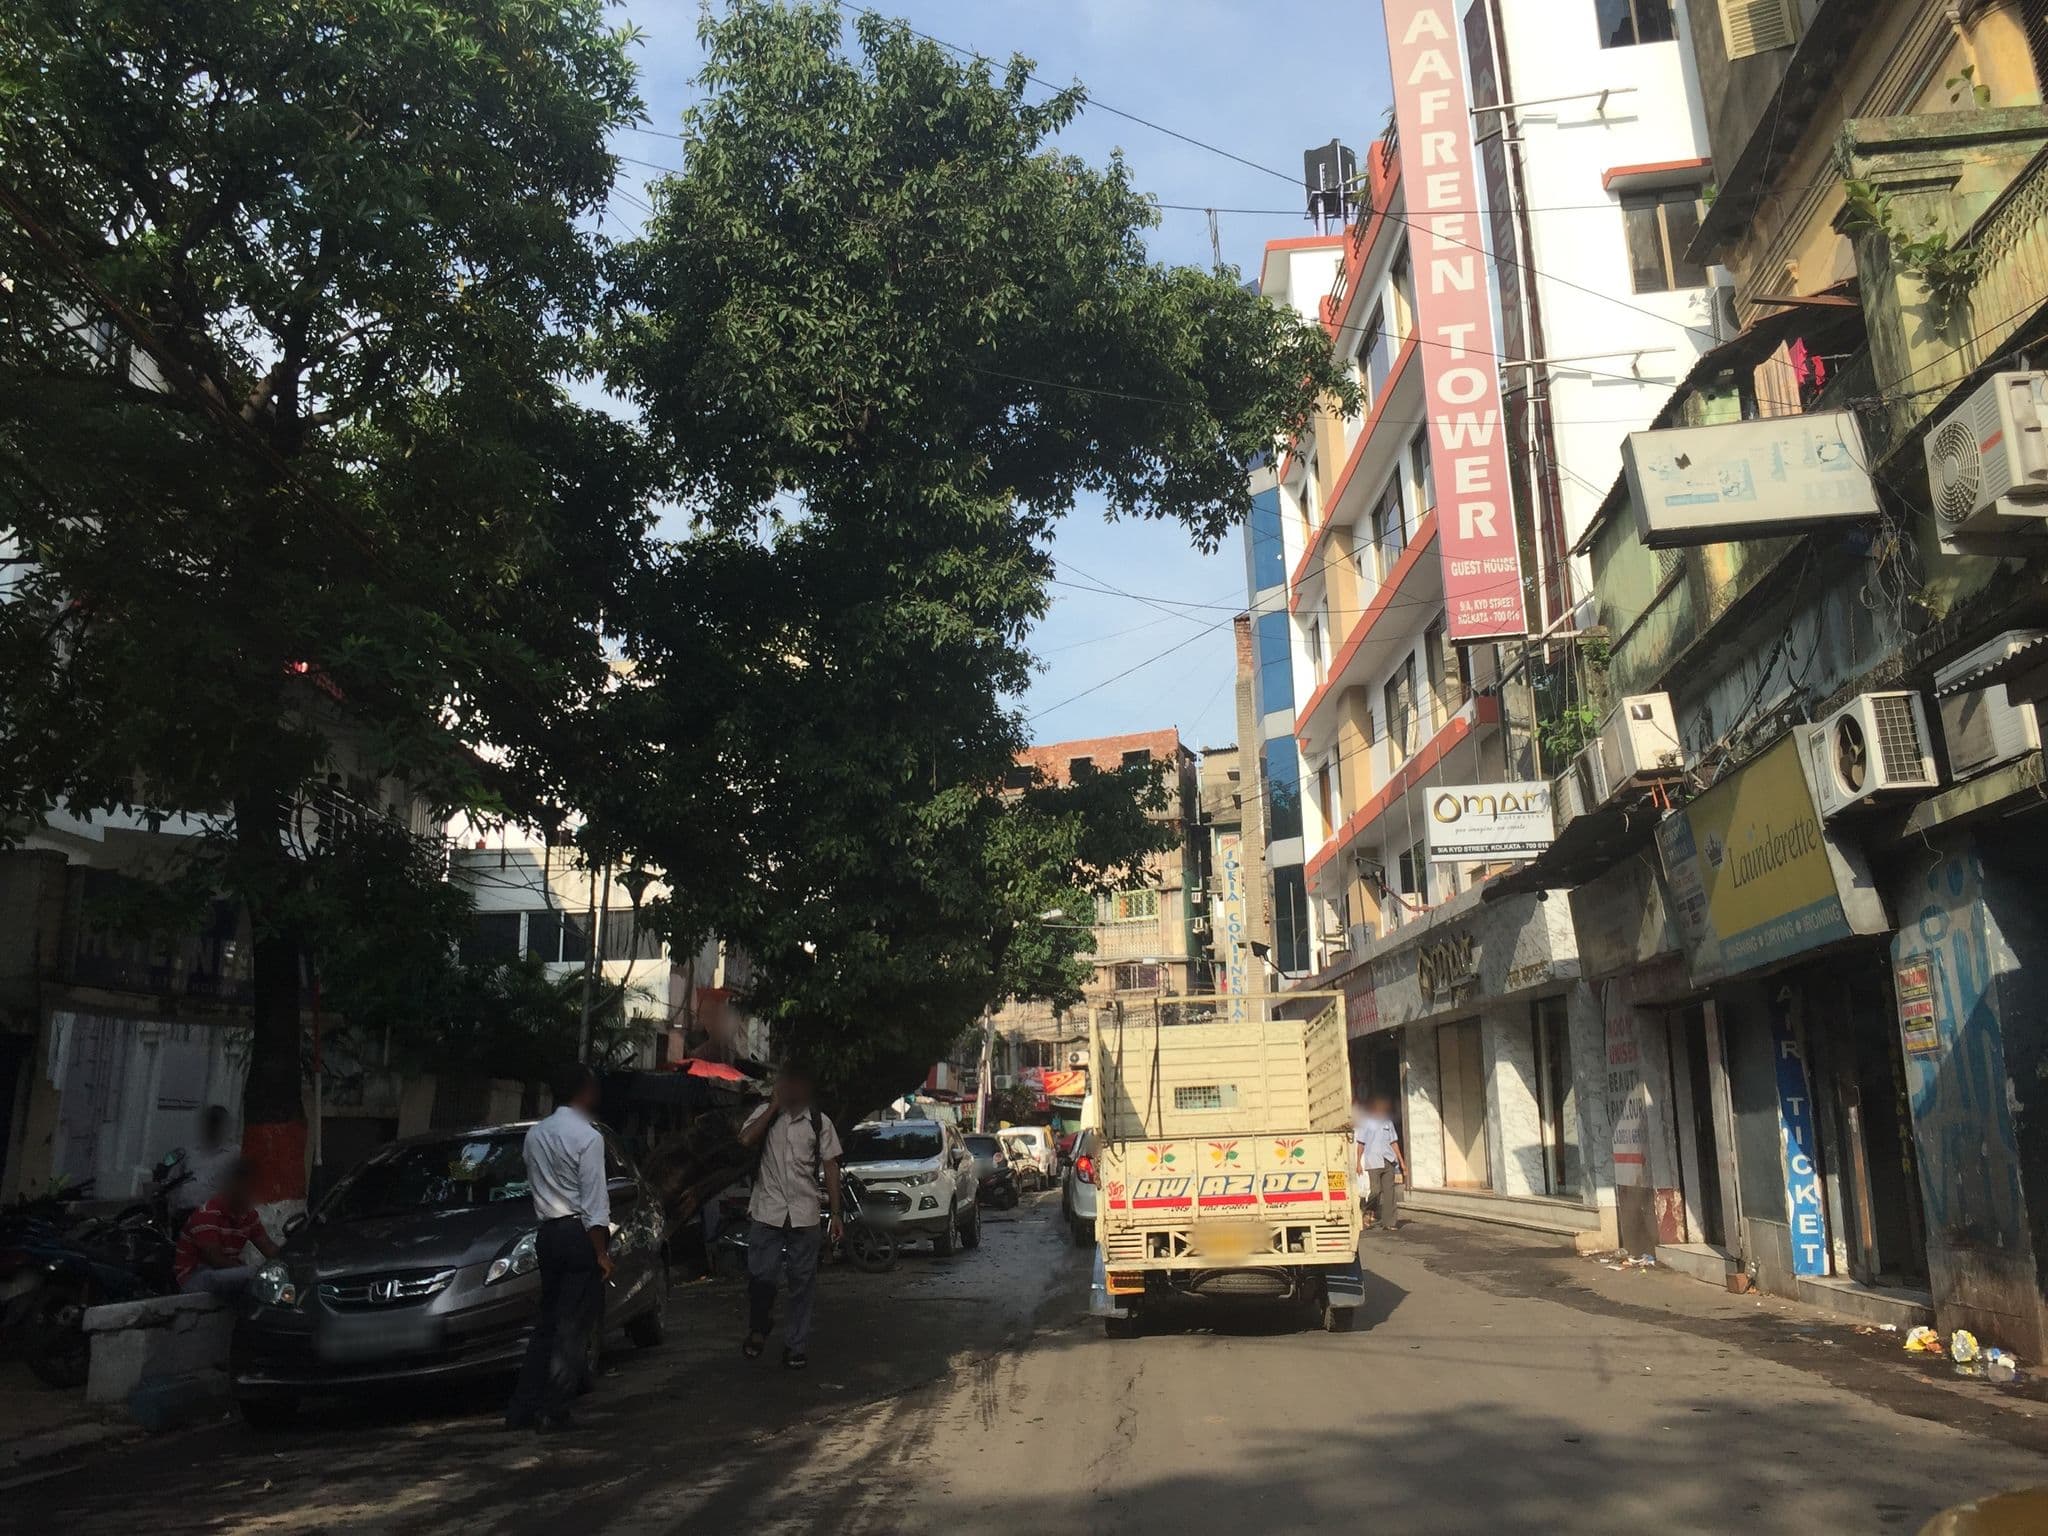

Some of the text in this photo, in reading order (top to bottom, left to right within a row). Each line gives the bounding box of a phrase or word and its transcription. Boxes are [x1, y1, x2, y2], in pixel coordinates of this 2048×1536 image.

[1402, 8, 1498, 540] AAFREEN TOWER
[1451, 557, 1517, 577] GUEST HOUSE
[1489, 597, 1514, 609] STREET
[1458, 612, 1489, 624] KOLKATA
[1491, 843, 1521, 852] KOLKATA
[1776, 985, 1819, 1264] AIR TICKET
